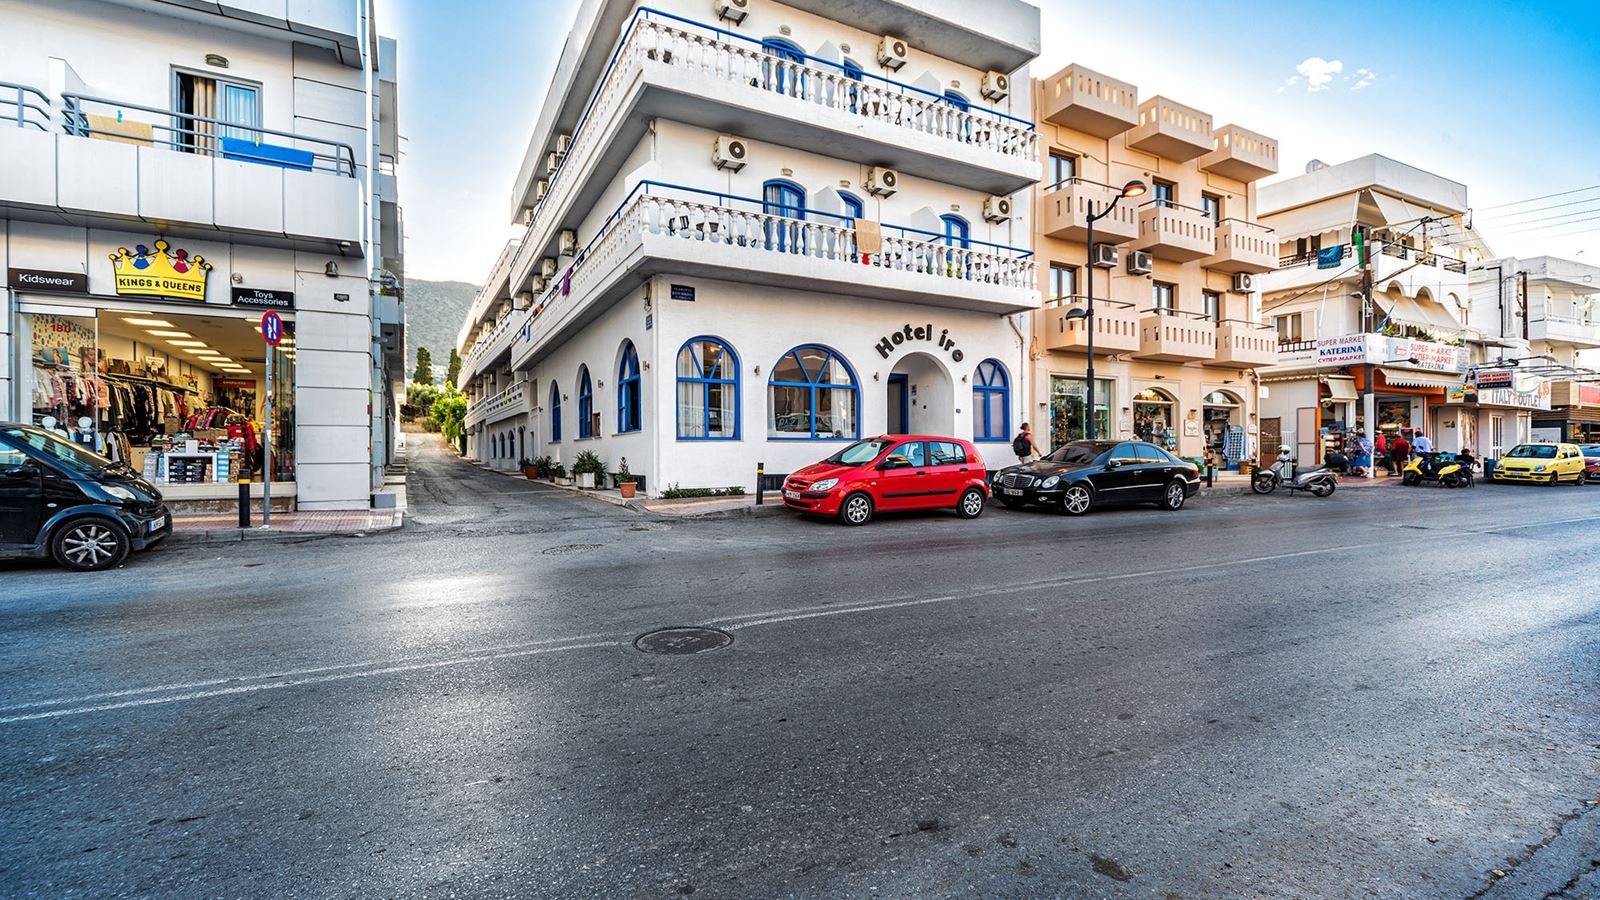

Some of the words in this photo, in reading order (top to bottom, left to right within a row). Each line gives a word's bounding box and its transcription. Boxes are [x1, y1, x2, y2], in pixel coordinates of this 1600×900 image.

[19, 273, 74, 286] Kidswear
[119, 278, 153, 287] KINGS
[162, 280, 201, 292] QUEENS
[253, 290, 273, 299] Toys
[237, 295, 289, 306] Accessories
[875, 323, 932, 359] Hotel
[938, 329, 963, 362] iro
[1317, 339, 1337, 347] SUPER
[1338, 336, 1365, 344] MARKET
[1320, 345, 1362, 355] KATERINA
[1410, 343, 1429, 353] SUPER
[1492, 389, 1512, 405] ITALY
